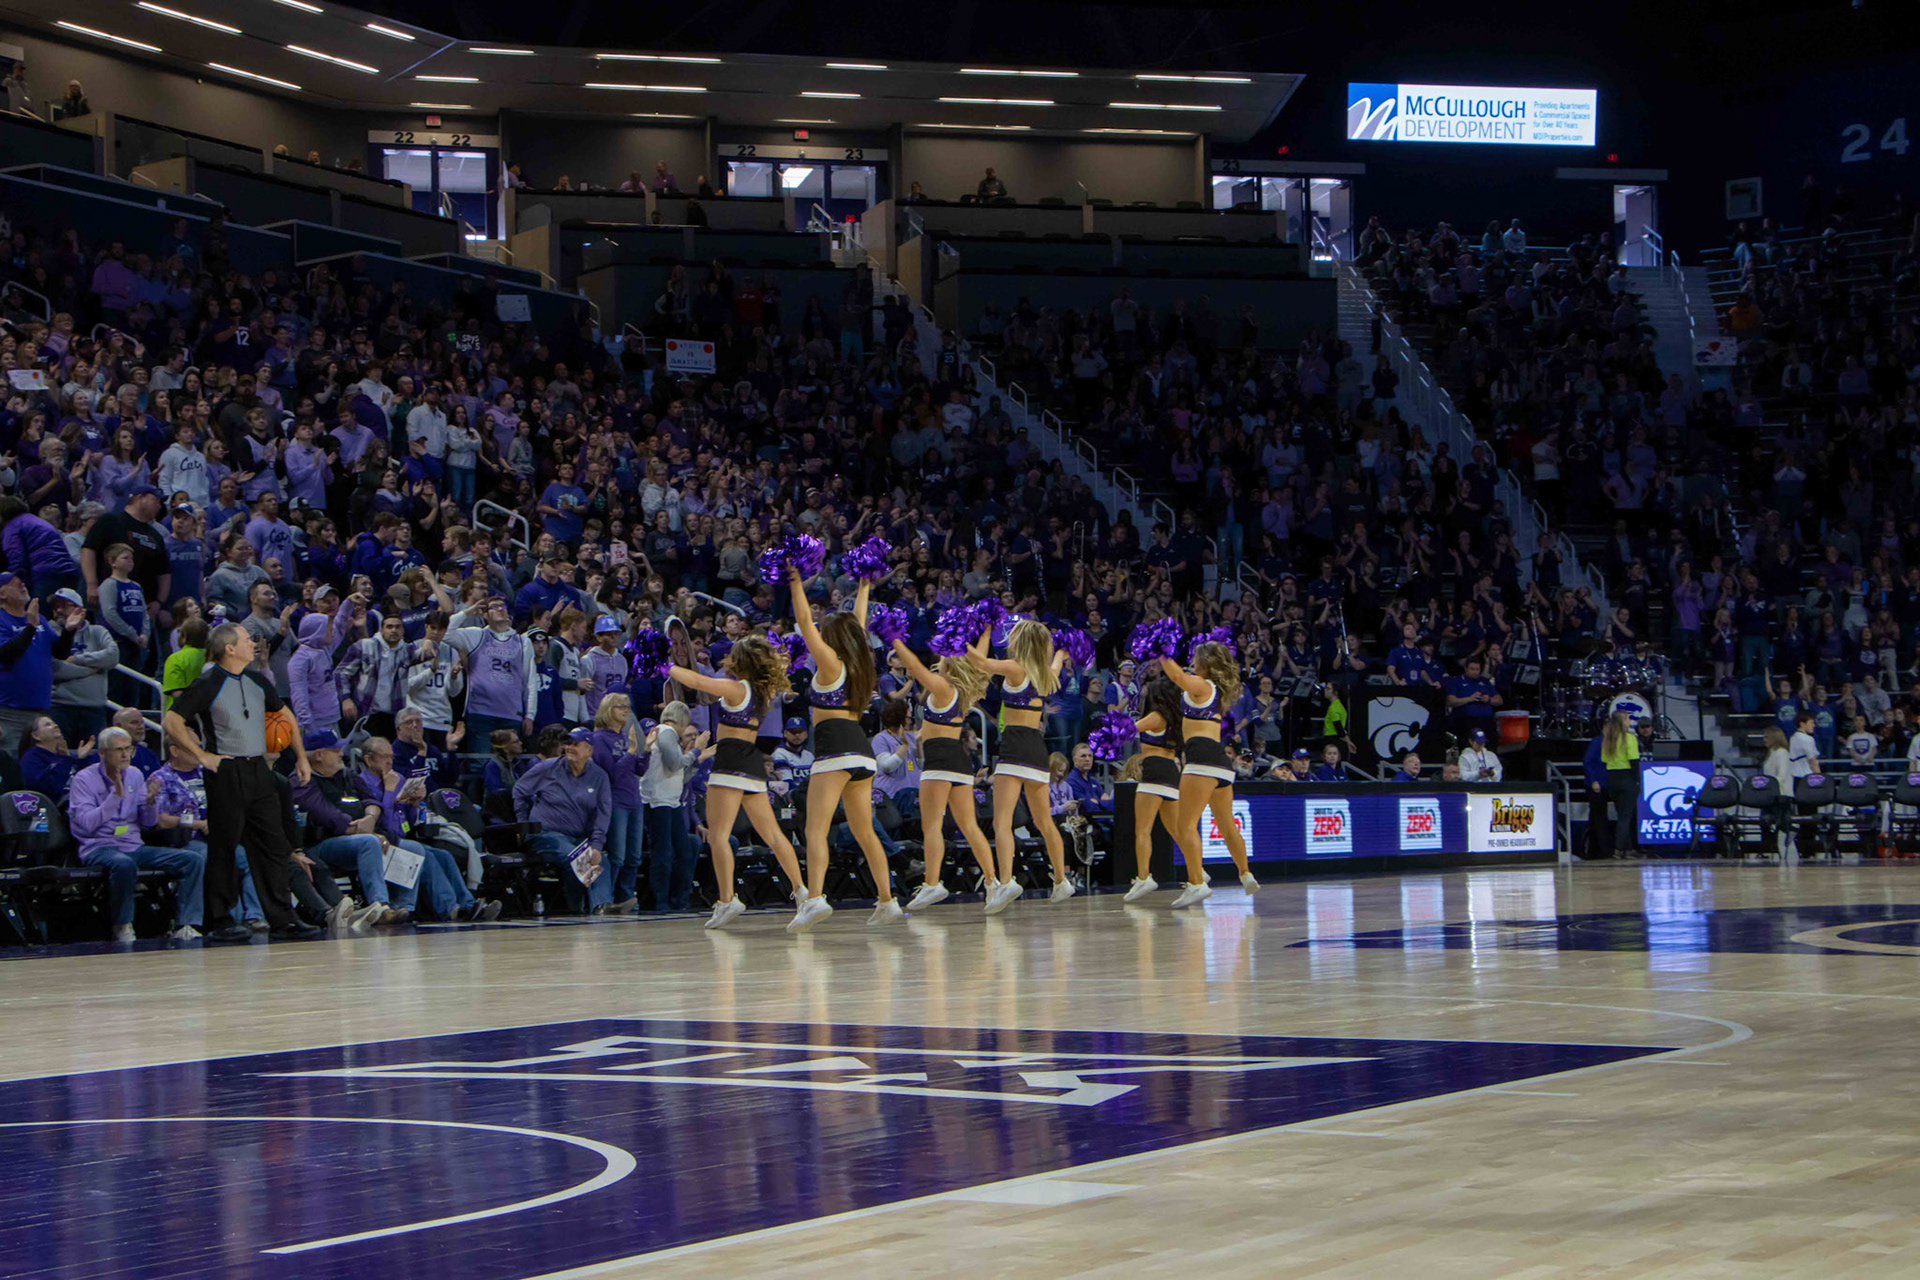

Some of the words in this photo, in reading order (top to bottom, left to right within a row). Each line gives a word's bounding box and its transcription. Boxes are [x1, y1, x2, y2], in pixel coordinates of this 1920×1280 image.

[1404, 119, 1526, 139] DEVELOPMENT
[394, 131, 415, 144] 22
[451, 134, 471, 147] 22
[1840, 117, 1910, 163] 24
[737, 145, 756, 157] 22
[845, 148, 864, 160] 23
[1223, 159, 1240, 171] 23
[234, 330, 250, 346] 12
[180, 456, 203, 472] Cats
[491, 658, 512, 674] 24
[1491, 796, 1535, 833] Briggs
[1313, 816, 1342, 836] ZERO
[1406, 814, 1433, 833] ZERO
